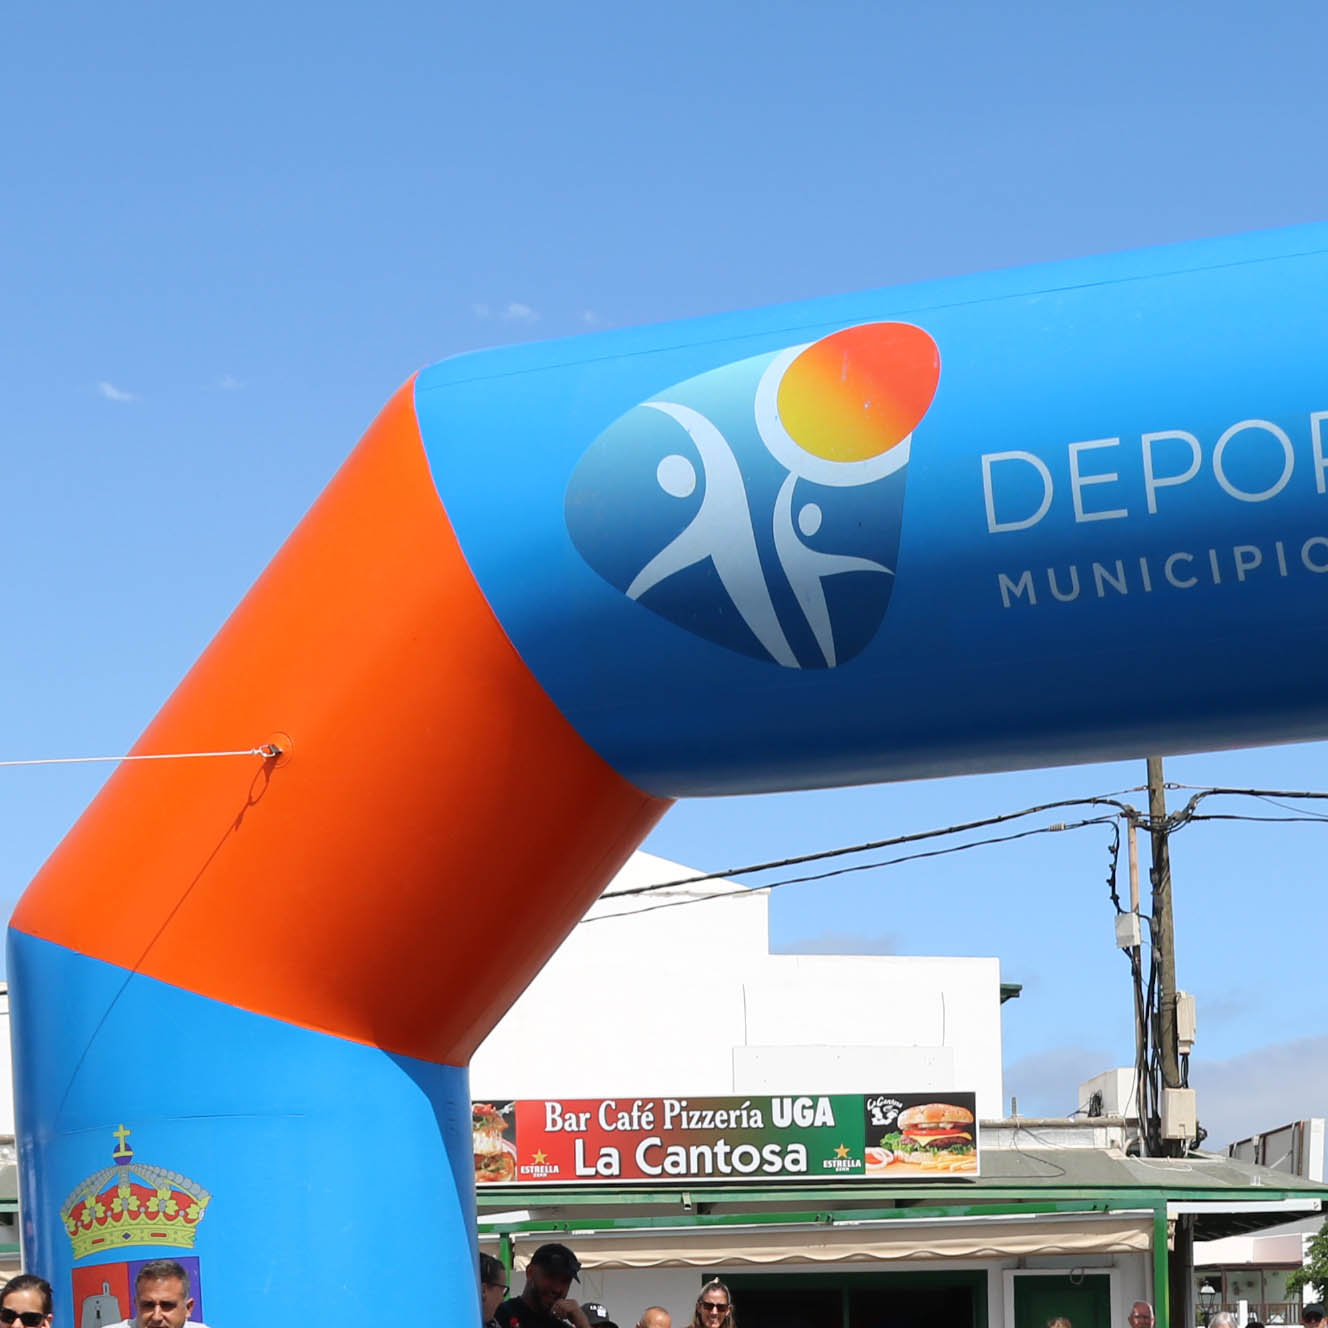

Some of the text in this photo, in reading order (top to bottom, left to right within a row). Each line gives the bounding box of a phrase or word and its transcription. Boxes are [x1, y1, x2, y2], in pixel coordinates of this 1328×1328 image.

[544, 1096, 835, 1132] Bar Café Pizzería UGA
[575, 1136, 808, 1177] La Cantosa
[823, 1159, 862, 1168] ESTRELLA
[520, 1164, 560, 1174] ESTRELLA
